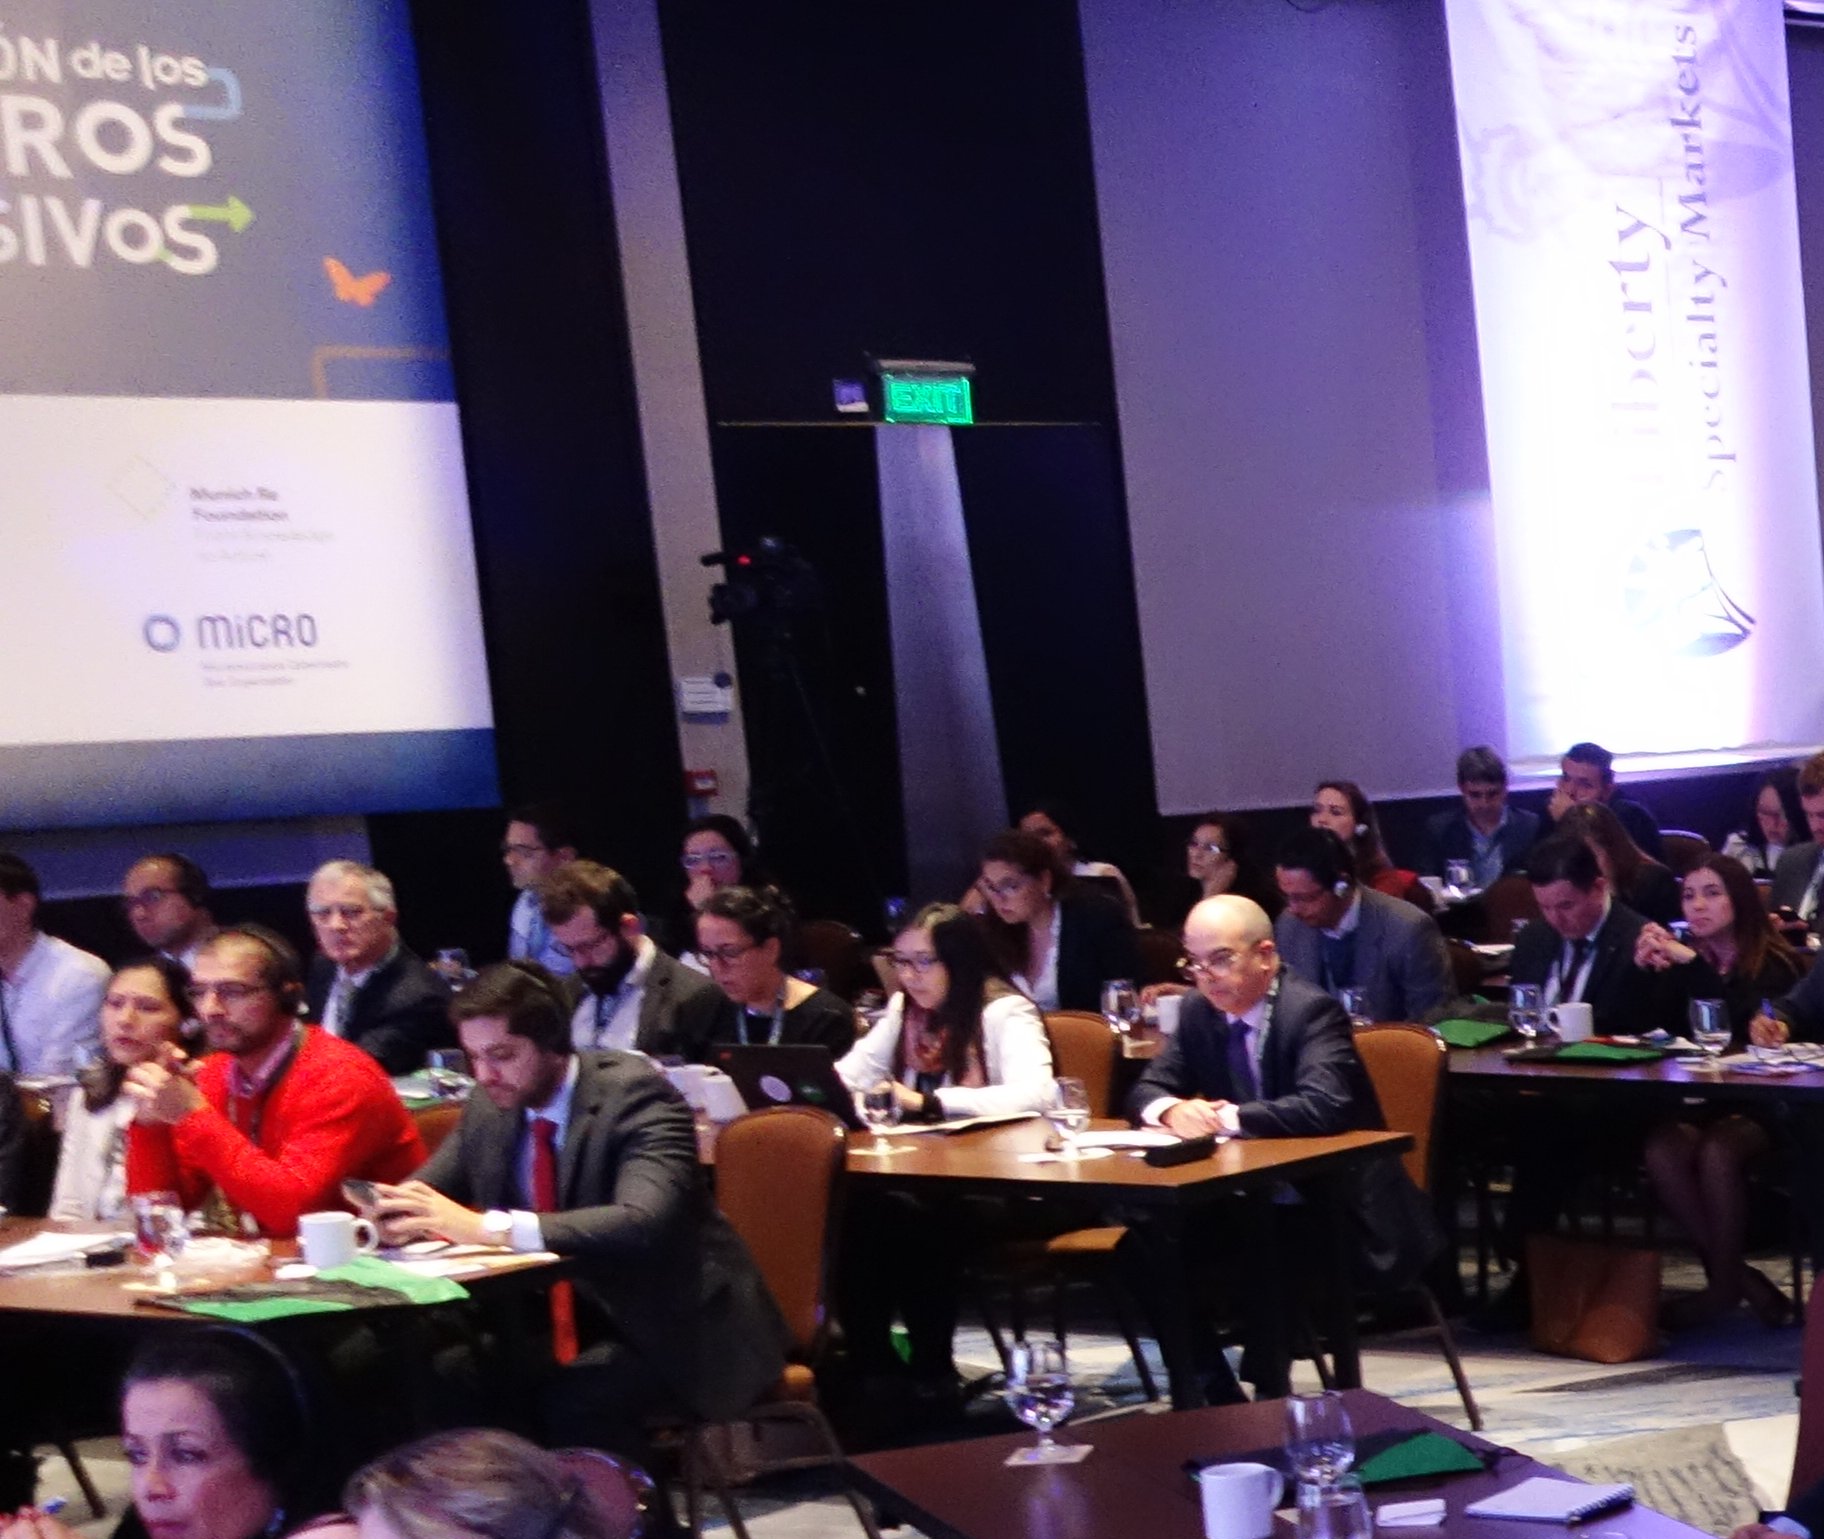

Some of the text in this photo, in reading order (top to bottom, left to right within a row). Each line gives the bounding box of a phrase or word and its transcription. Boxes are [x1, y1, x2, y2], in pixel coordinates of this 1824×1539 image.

[71, 43, 133, 82] de
[139, 45, 209, 89] los
[0, 95, 213, 179] ROS
[1670, 23, 1738, 493] Specialty Markets
[890, 381, 963, 414] EXIT
